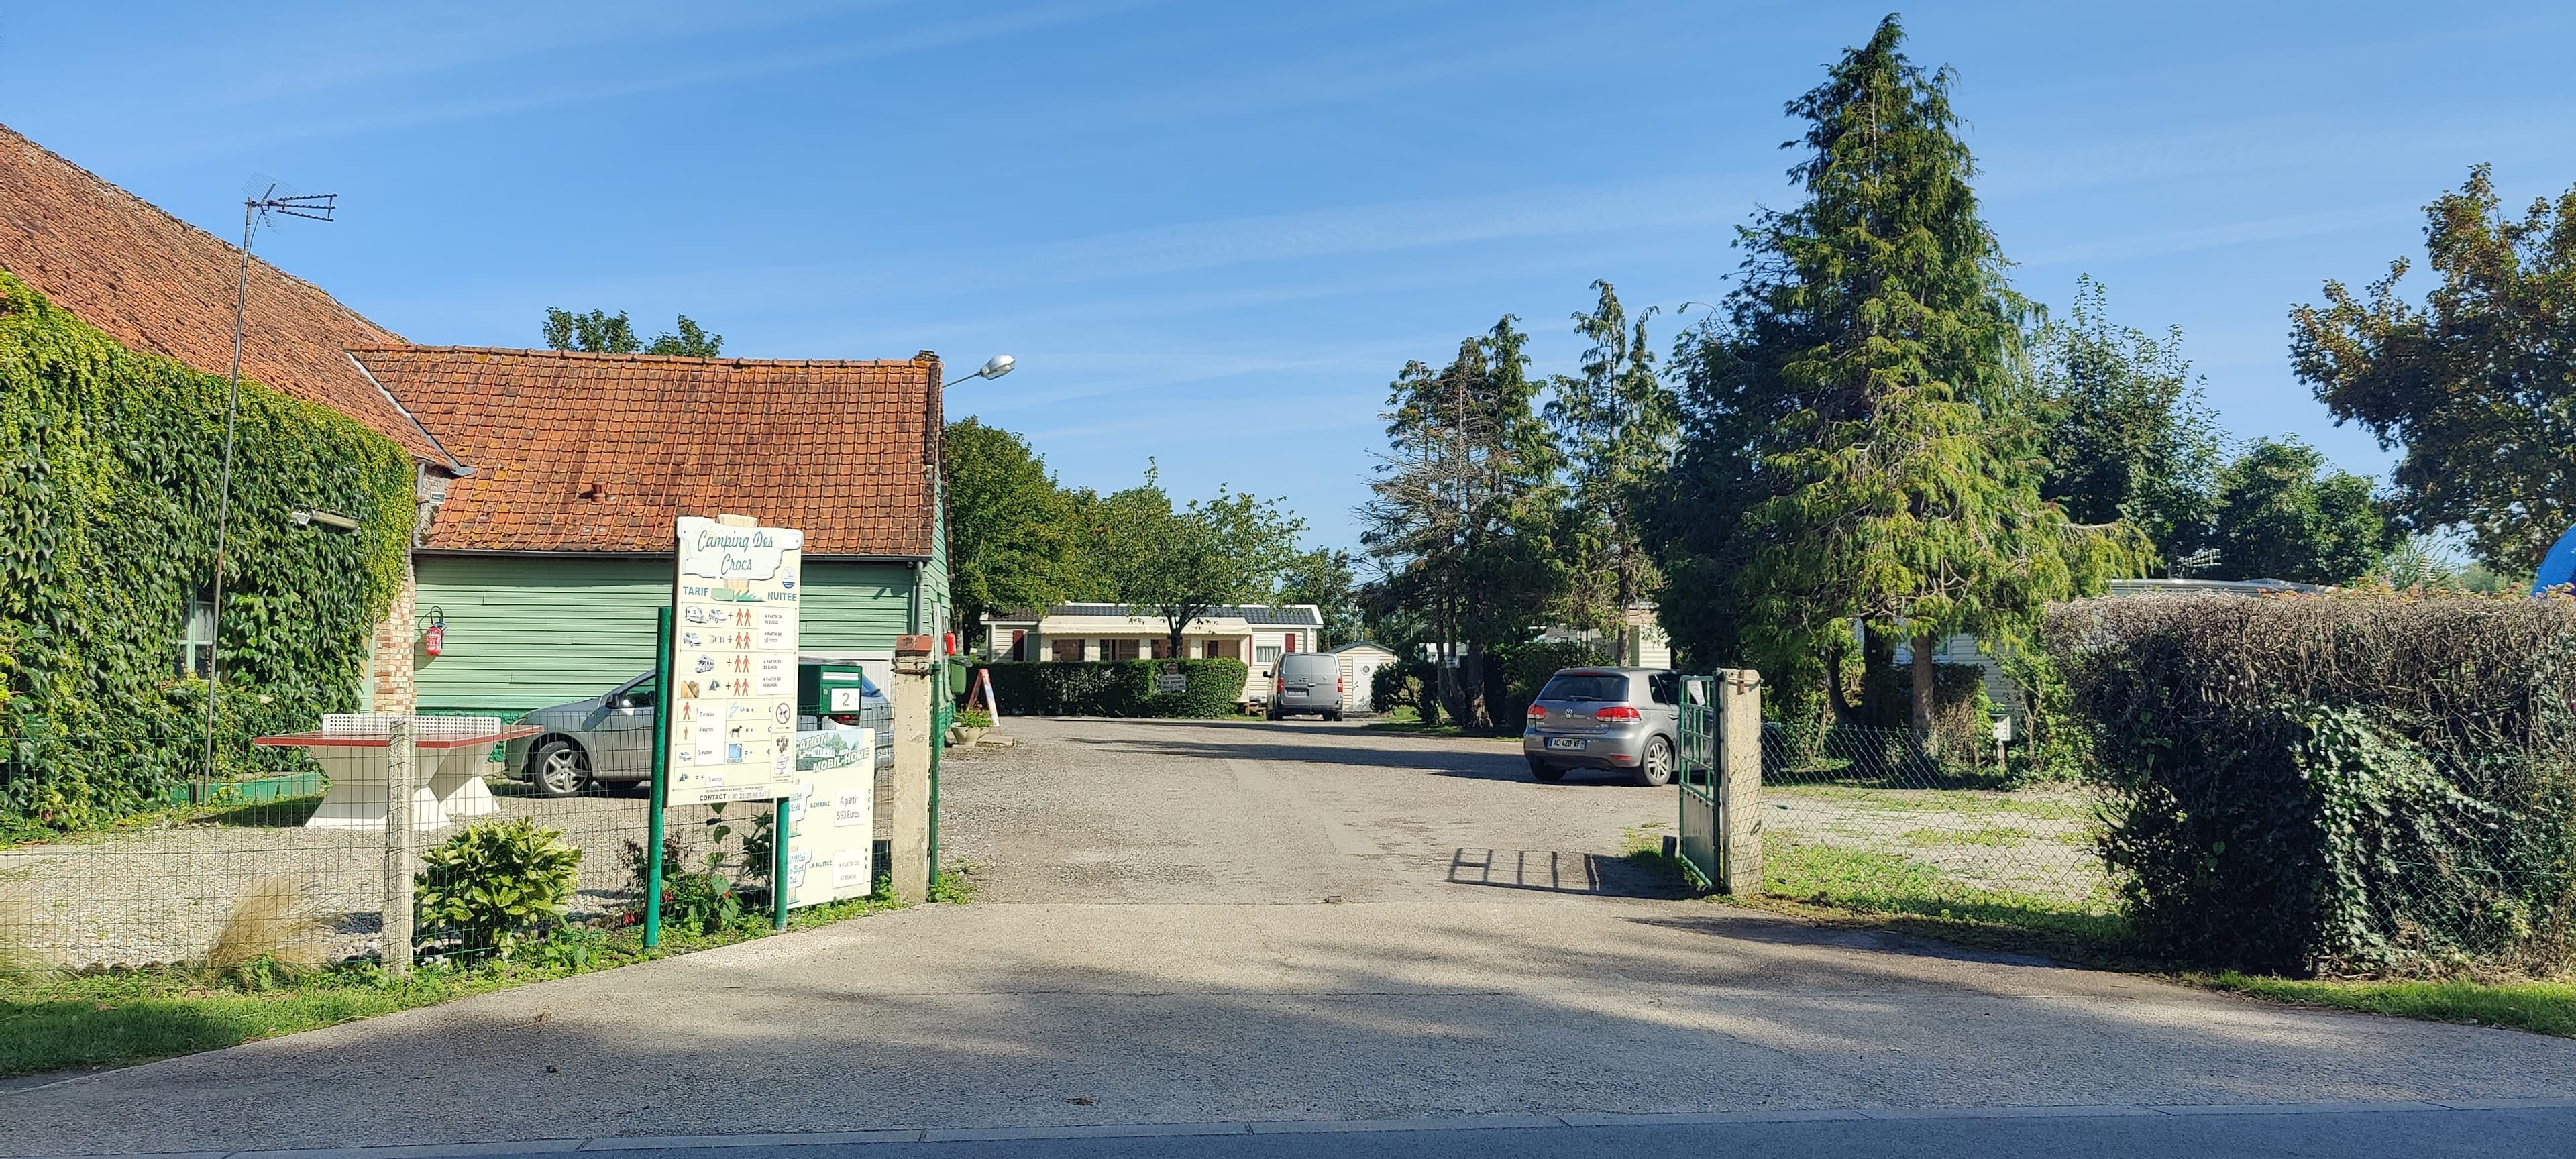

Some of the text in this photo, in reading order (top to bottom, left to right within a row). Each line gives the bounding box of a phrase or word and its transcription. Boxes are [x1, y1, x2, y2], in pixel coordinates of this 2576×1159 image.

[698, 530, 773, 553] Camping Des
[720, 553, 752, 575] Crocs
[683, 586, 709, 596] TARIF
[767, 592, 797, 602] NUITEE
[843, 692, 849, 706] 2
[840, 796, 845, 805] A
[845, 796, 859, 806] partir
[847, 810, 861, 818] Euros
